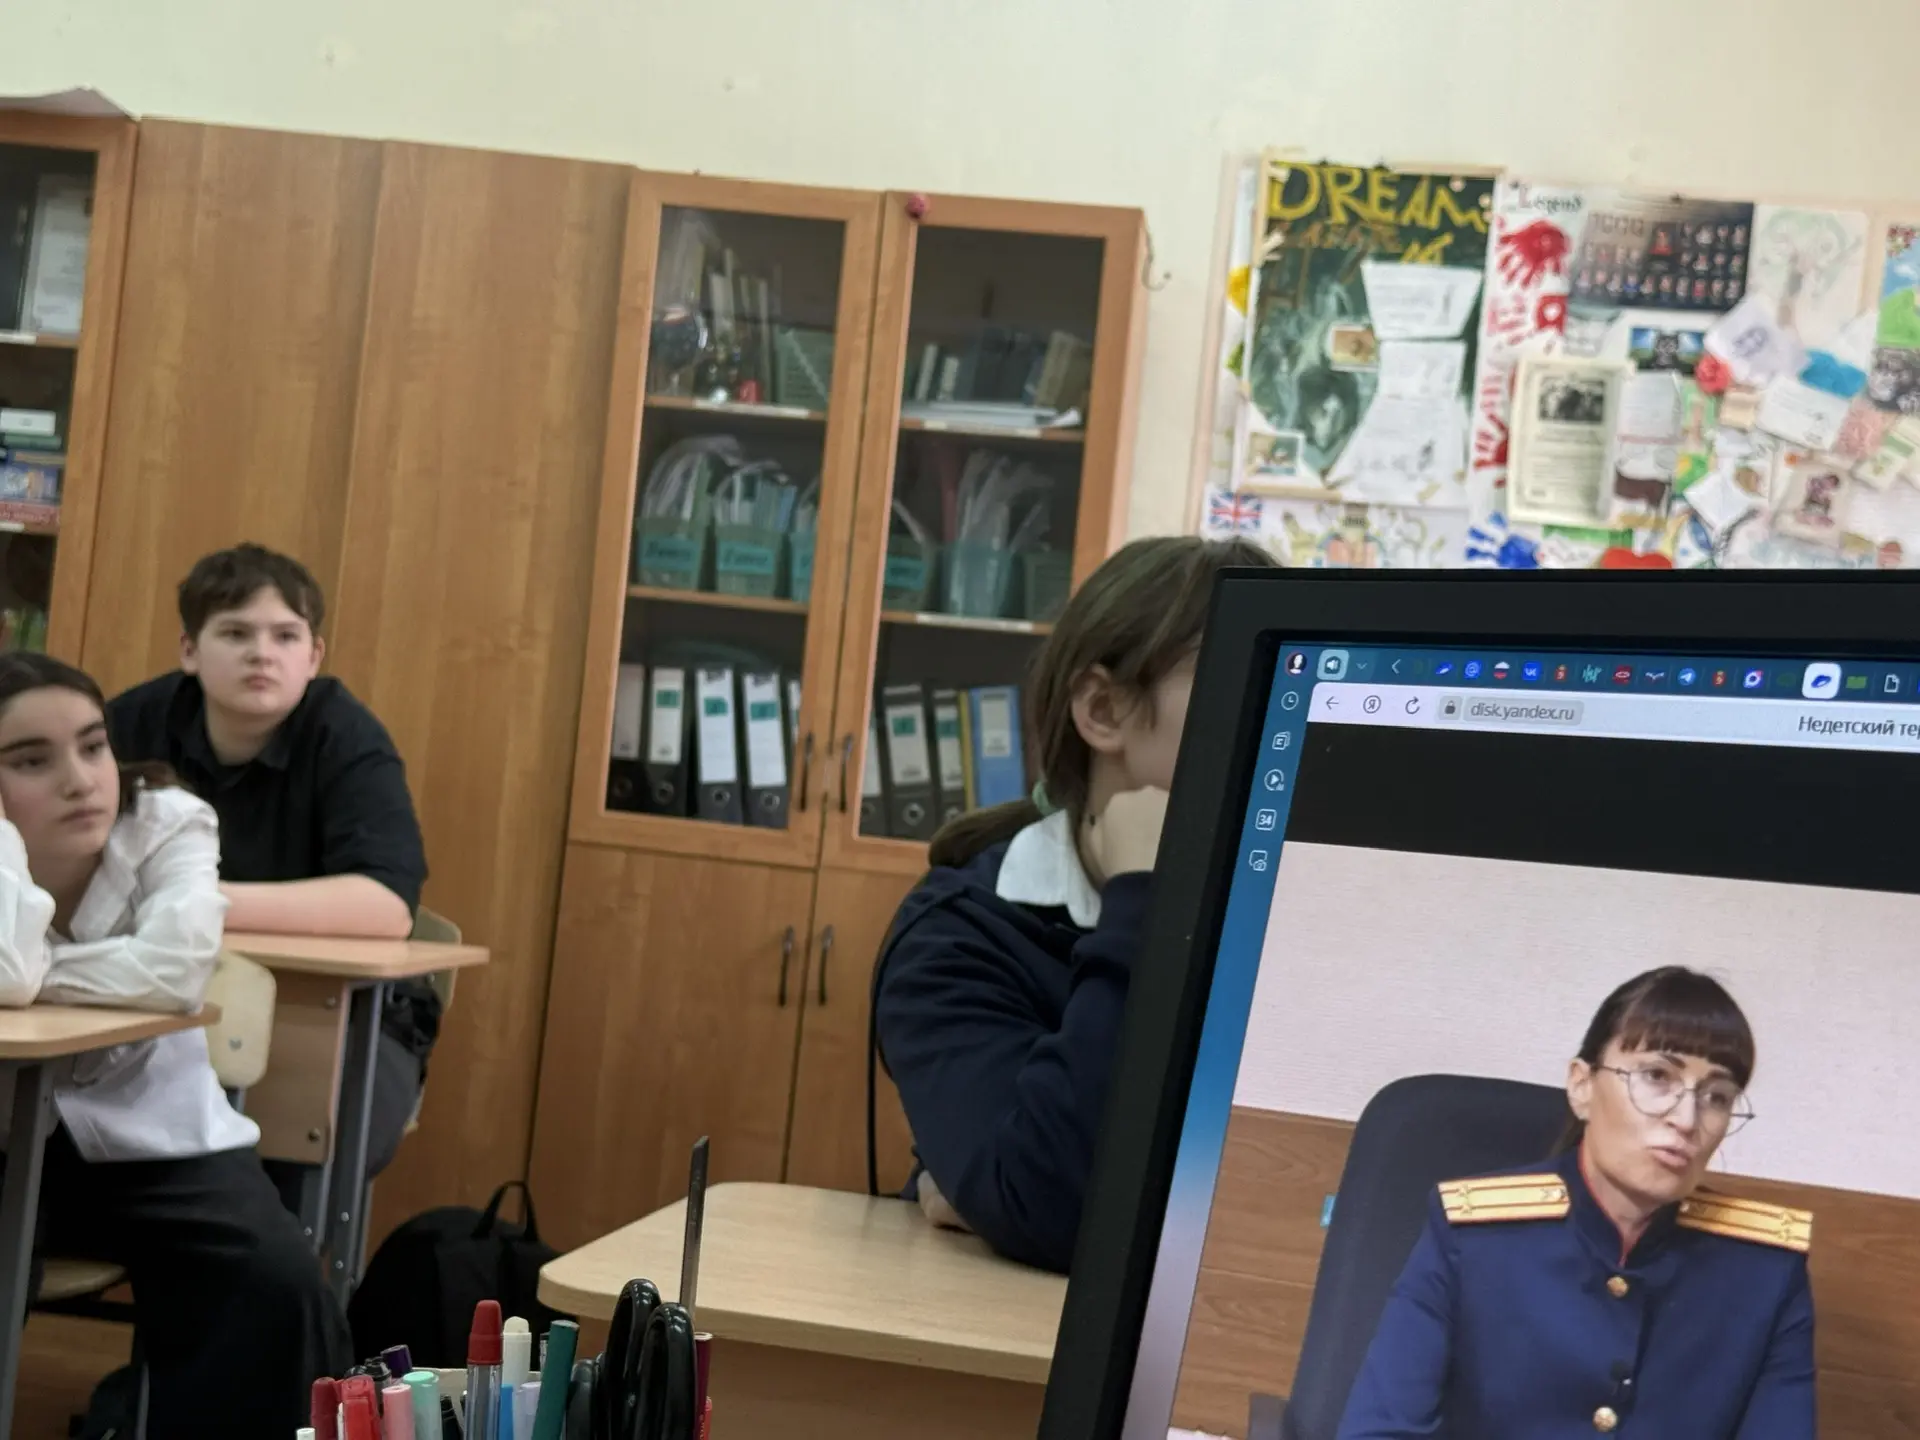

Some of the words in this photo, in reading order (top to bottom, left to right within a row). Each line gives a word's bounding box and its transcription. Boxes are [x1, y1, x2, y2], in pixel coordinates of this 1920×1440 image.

[1470, 703, 1574, 721] disk.yandex.ru
[1798, 715, 1895, 736] Недетский
[1258, 814, 1273, 826] 34
